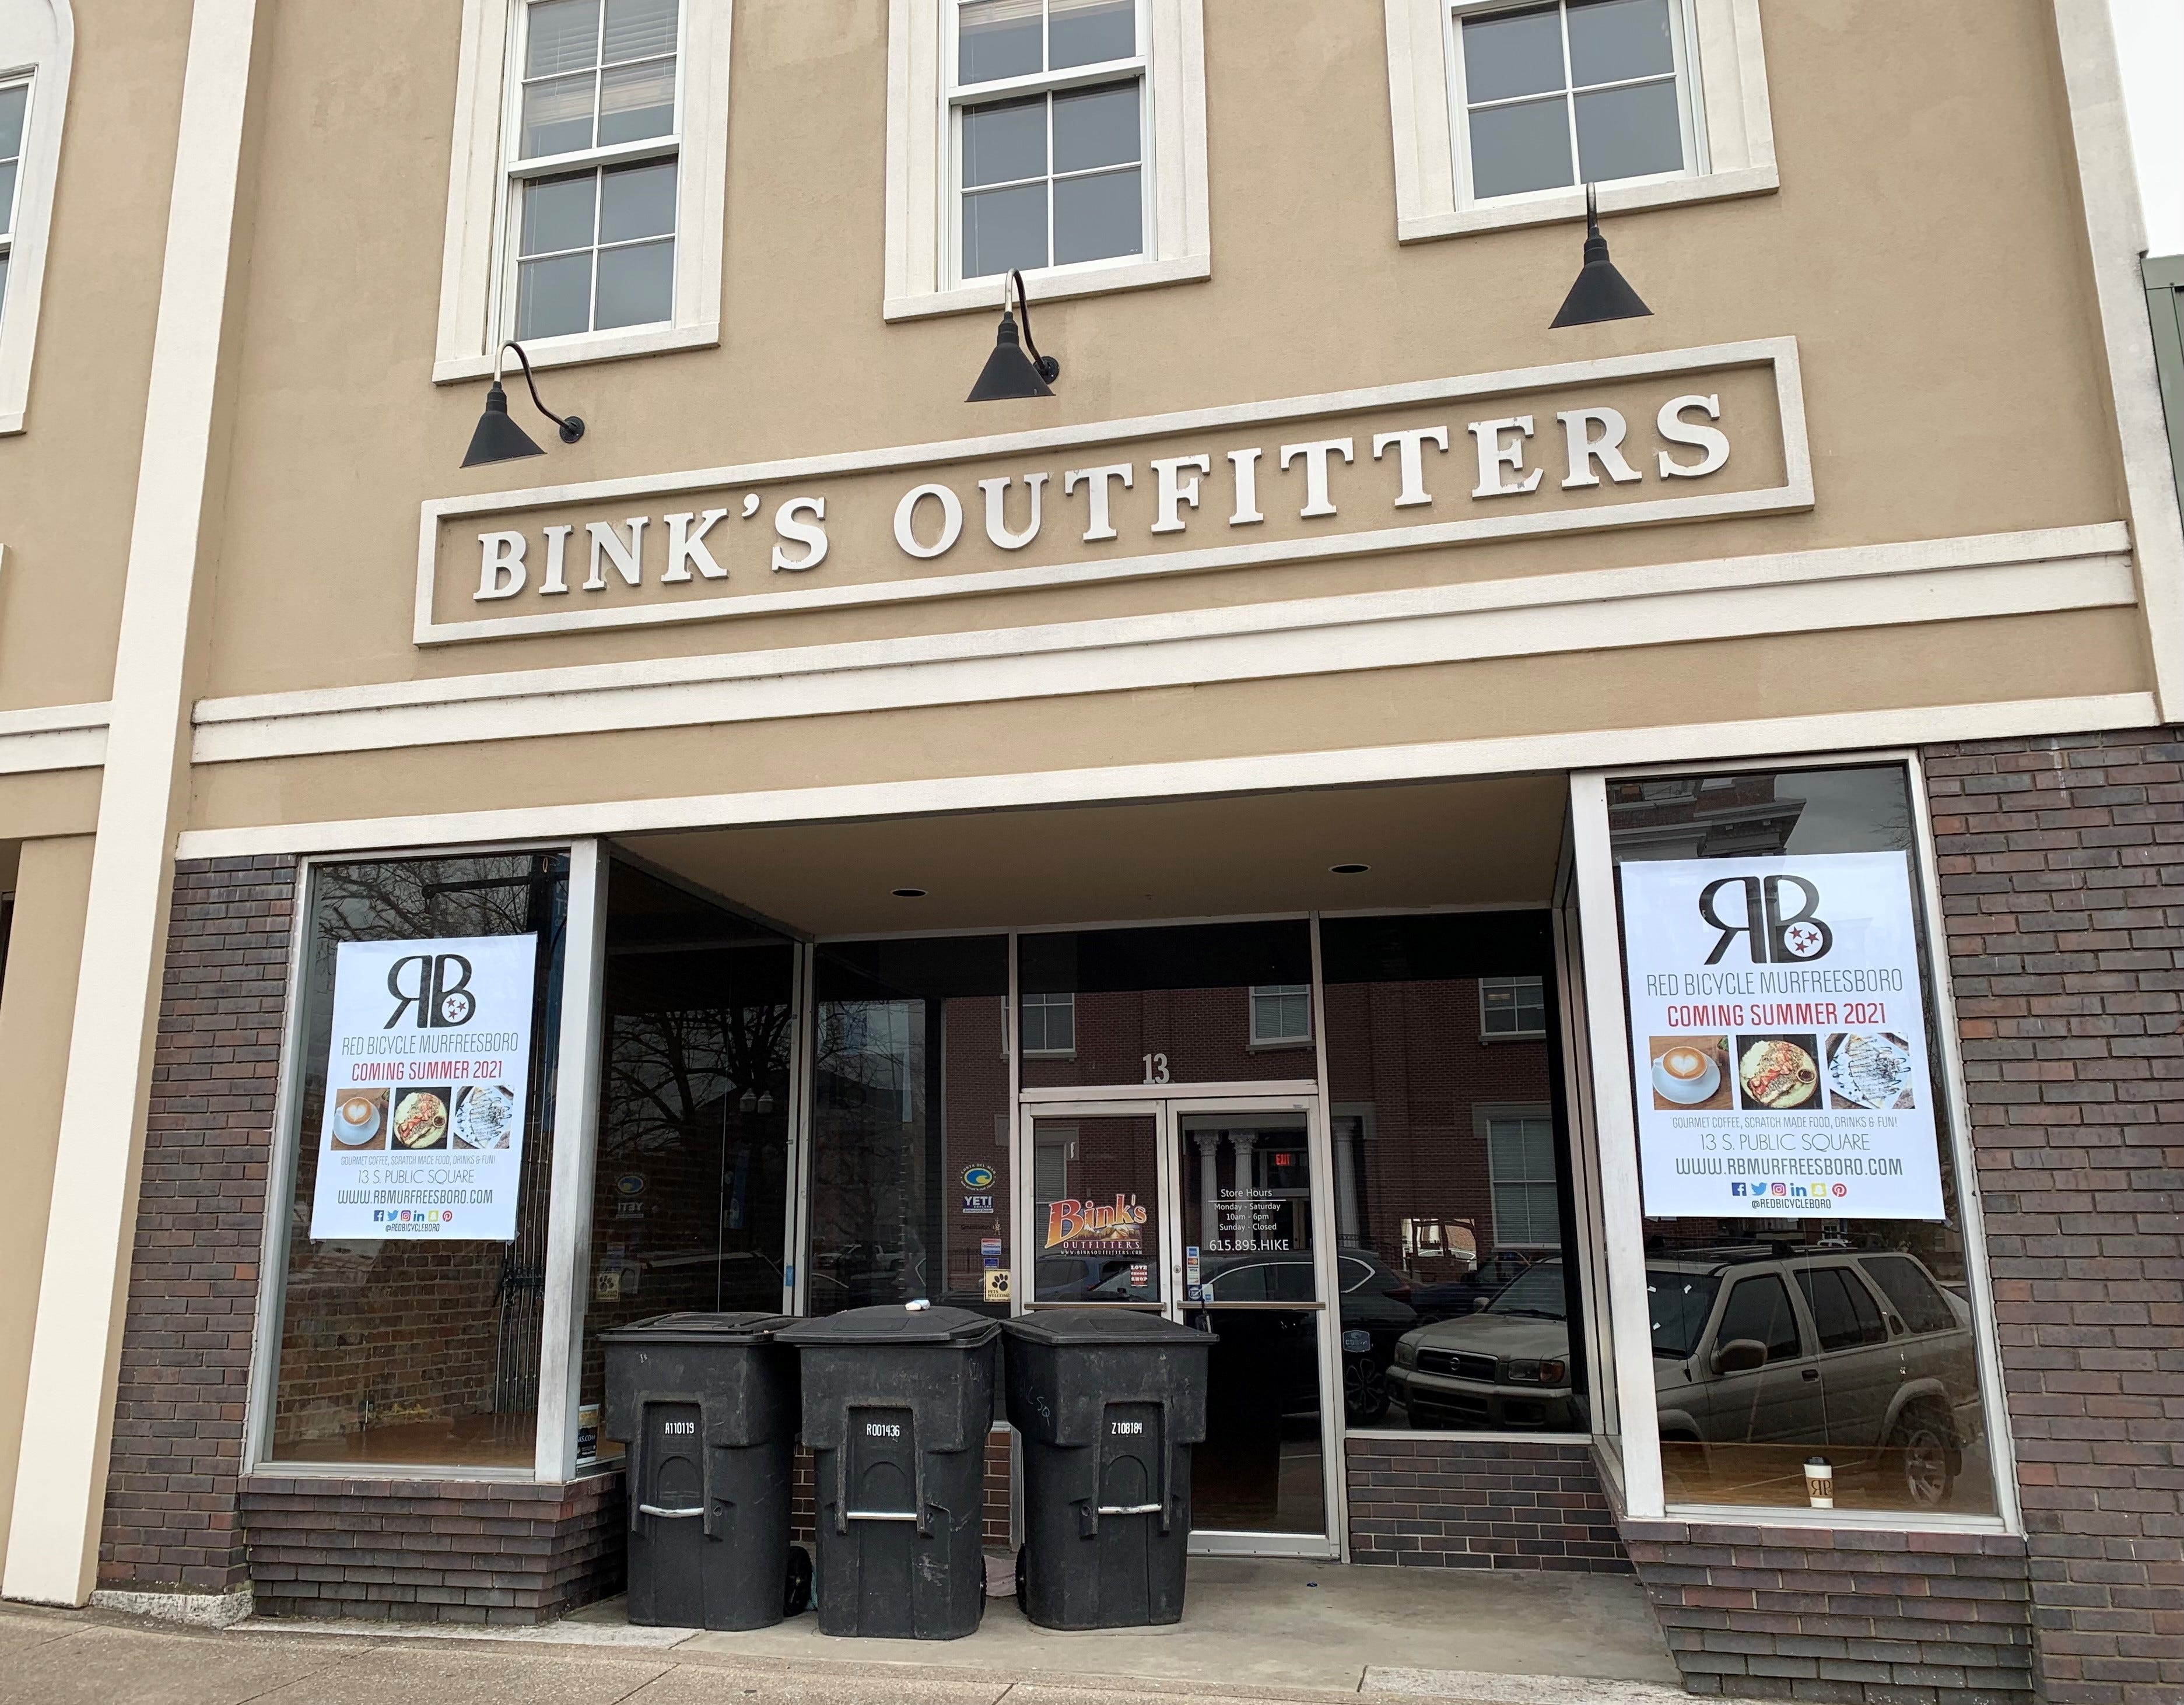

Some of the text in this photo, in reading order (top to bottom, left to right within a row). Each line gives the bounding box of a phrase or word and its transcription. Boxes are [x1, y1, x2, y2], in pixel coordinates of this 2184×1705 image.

[473, 393, 1730, 602] BINK'S OUTFITTERS
[1647, 968, 1903, 996] RED BICYCLE MURFREESBORO
[1667, 1002, 1886, 1027] COMING SUMMER 2021
[342, 1032, 518, 1055] RED BICYCLE MURFREESBORO
[352, 1060, 502, 1081] COMING SUMMER 2021
[1143, 1053, 1170, 1084] 13
[1673, 1116, 1897, 1129] GOURMET COFFEE, SCRATCH MADE FOOD, DRINKS & FUN!
[1700, 1133, 1870, 1152] 13 S. PUBLIC SQUARE
[341, 1155, 496, 1167] GOURMET COFFEE, SCRATCH MADE FOOD, DRINKS & FUN!
[1275, 1153, 1291, 1166] EXIT
[1675, 1158, 1903, 1176] WWW.RBMURFREESBORO.COM
[358, 1169, 474, 1185] 13 S. PUBLIC SQUARE
[338, 1190, 493, 1204] WWW.RBMURFREESBORO.COM
[1221, 1188, 1272, 1197] Store Hours
[964, 1196, 993, 1206] YETI
[1214, 1204, 1242, 1212] Monday
[1249, 1203, 1281, 1211] Saturday
[1751, 1199, 1831, 1209] @REDBICYCLEBORO
[385, 1223, 440, 1232] @REDBICYCLEBORO
[1044, 1194, 1147, 1249] Bink's
[1210, 1239, 1289, 1251] 615.895.HIKE
[665, 1422, 695, 1434] A110119
[867, 1423, 900, 1437] R001436
[1112, 1422, 1142, 1434] Z108184
